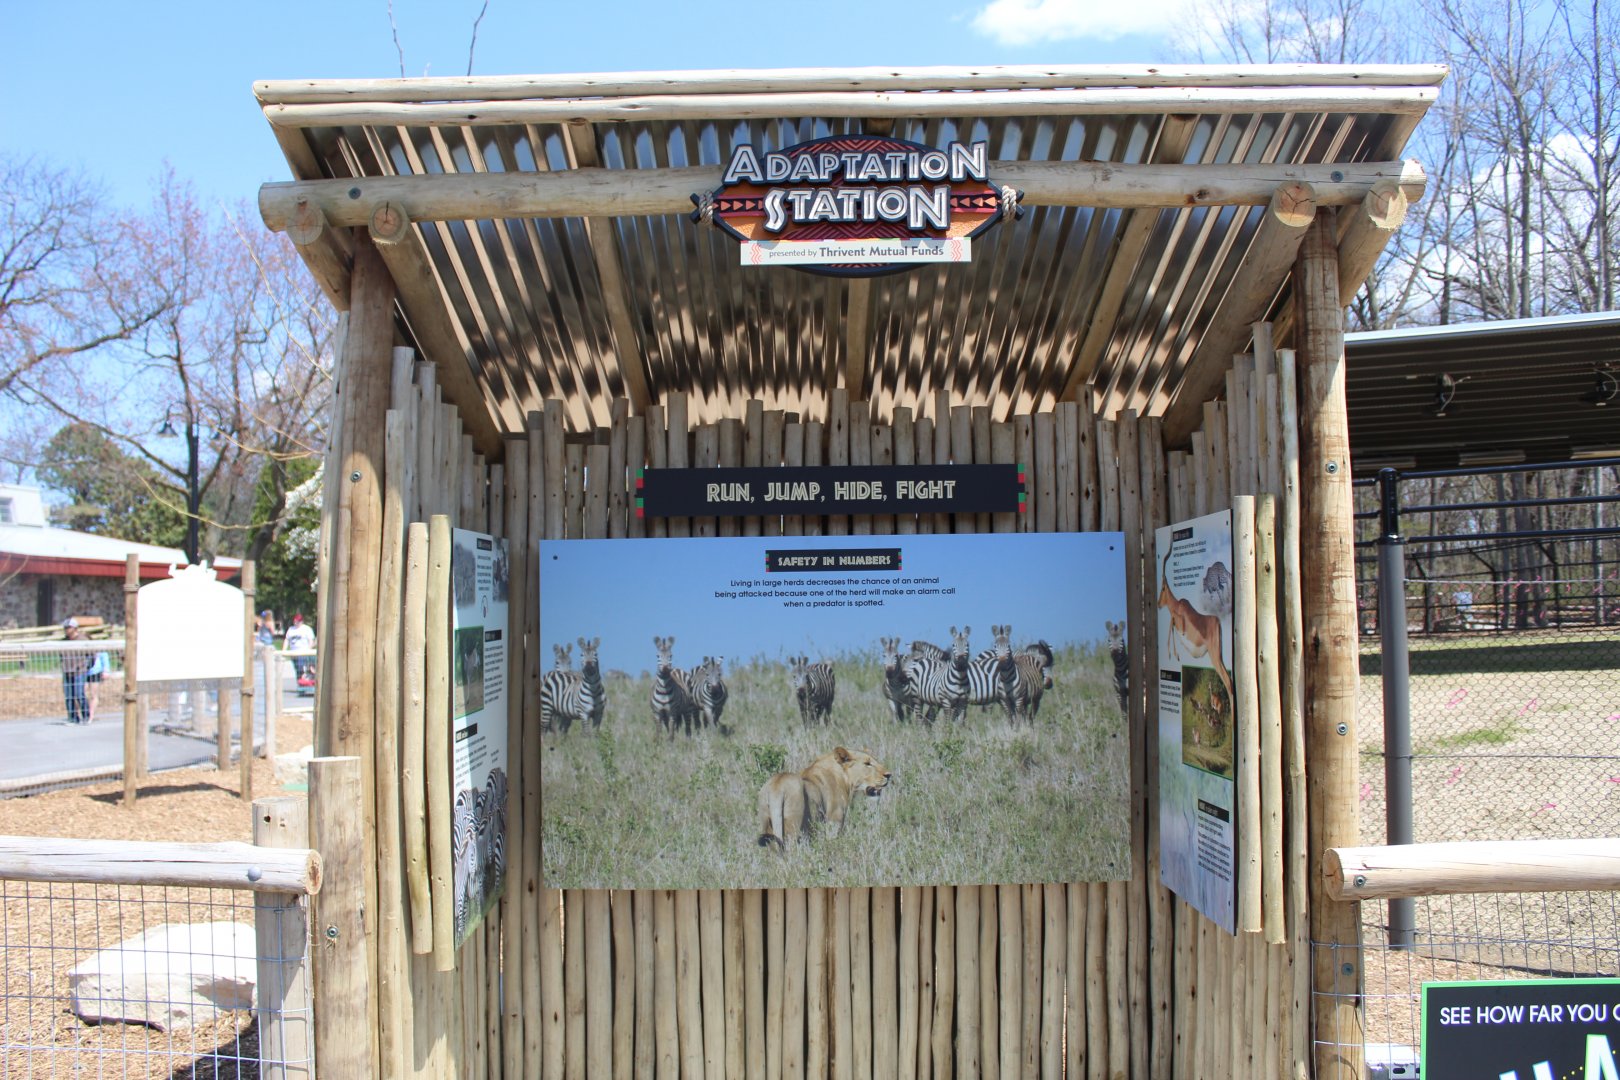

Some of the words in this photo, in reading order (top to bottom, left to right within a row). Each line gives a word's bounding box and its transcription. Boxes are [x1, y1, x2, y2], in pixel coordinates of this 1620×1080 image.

[724, 142, 987, 183] ADAPTATION
[764, 186, 949, 231] STATION
[769, 248, 806, 258] presented
[807, 248, 818, 258] by
[819, 247, 866, 257] Thrivent
[869, 246, 908, 256] Mutual
[911, 246, 944, 256] Funds
[706, 482, 755, 503] RUN,
[763, 481, 825, 502] JUMP,
[834, 481, 888, 502] HIDE,
[896, 480, 956, 500] FIGHT
[777, 556, 819, 567] SAFETY
[822, 556, 835, 566] IN
[838, 555, 892, 566] NUMBERS
[730, 580, 752, 588] Living
[762, 579, 782, 588] large
[806, 578, 846, 586] decreases
[892, 577, 900, 585] of
[714, 591, 737, 599] being
[738, 590, 773, 598] attacked
[849, 588, 867, 596] herd
[869, 588, 881, 596] will
[813, 600, 846, 608] predator
[847, 599, 853, 607] is
[854, 599, 885, 608] spotted.
[1439, 1006, 1471, 1025] SEE
[1476, 1005, 1524, 1024] HOW
[1529, 1004, 1563, 1023] FAR
[1567, 1003, 1607, 1022] YOU
